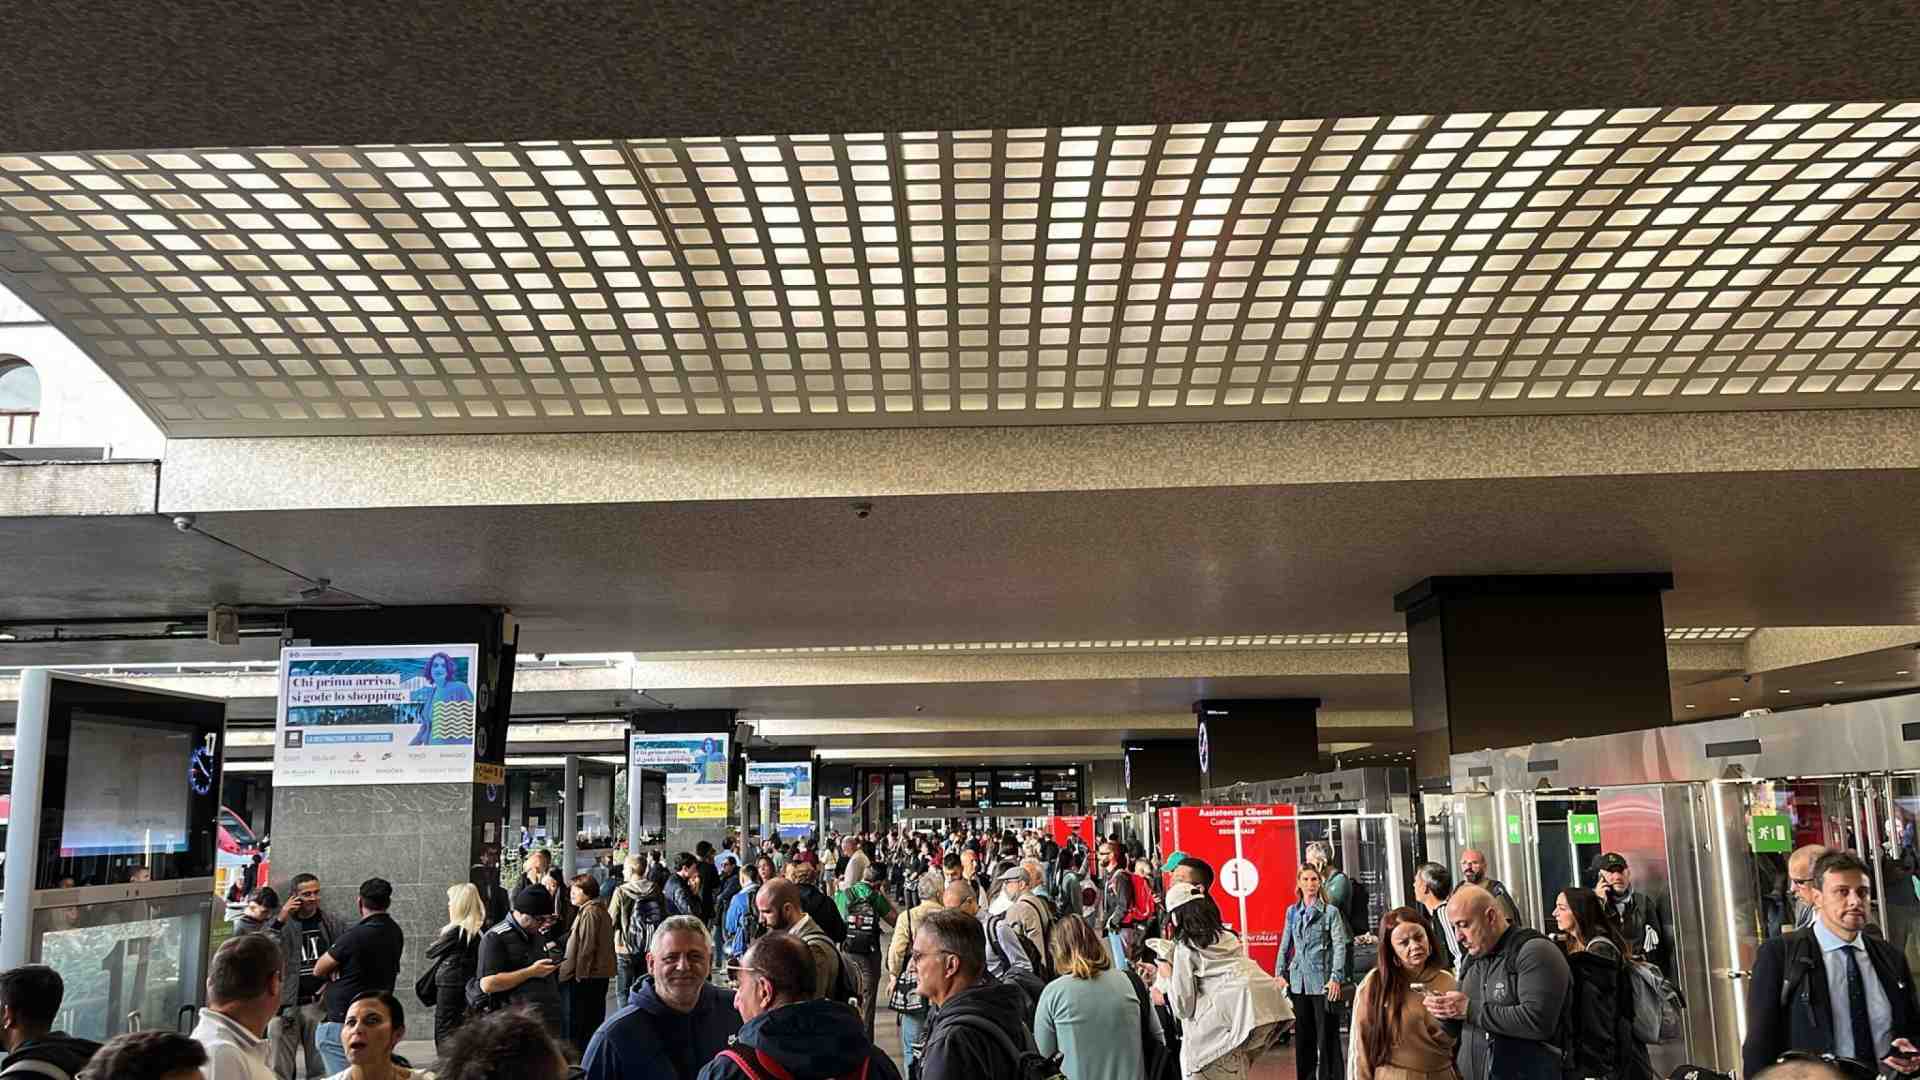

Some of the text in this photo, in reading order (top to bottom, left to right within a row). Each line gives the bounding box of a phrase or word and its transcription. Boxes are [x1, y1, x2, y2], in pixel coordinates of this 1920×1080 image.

[292, 677, 313, 687] Chi
[316, 676, 352, 689] prima
[291, 689, 406, 703] si gode lo shopping.
[1199, 807, 1273, 817] Assistenza Clienti
